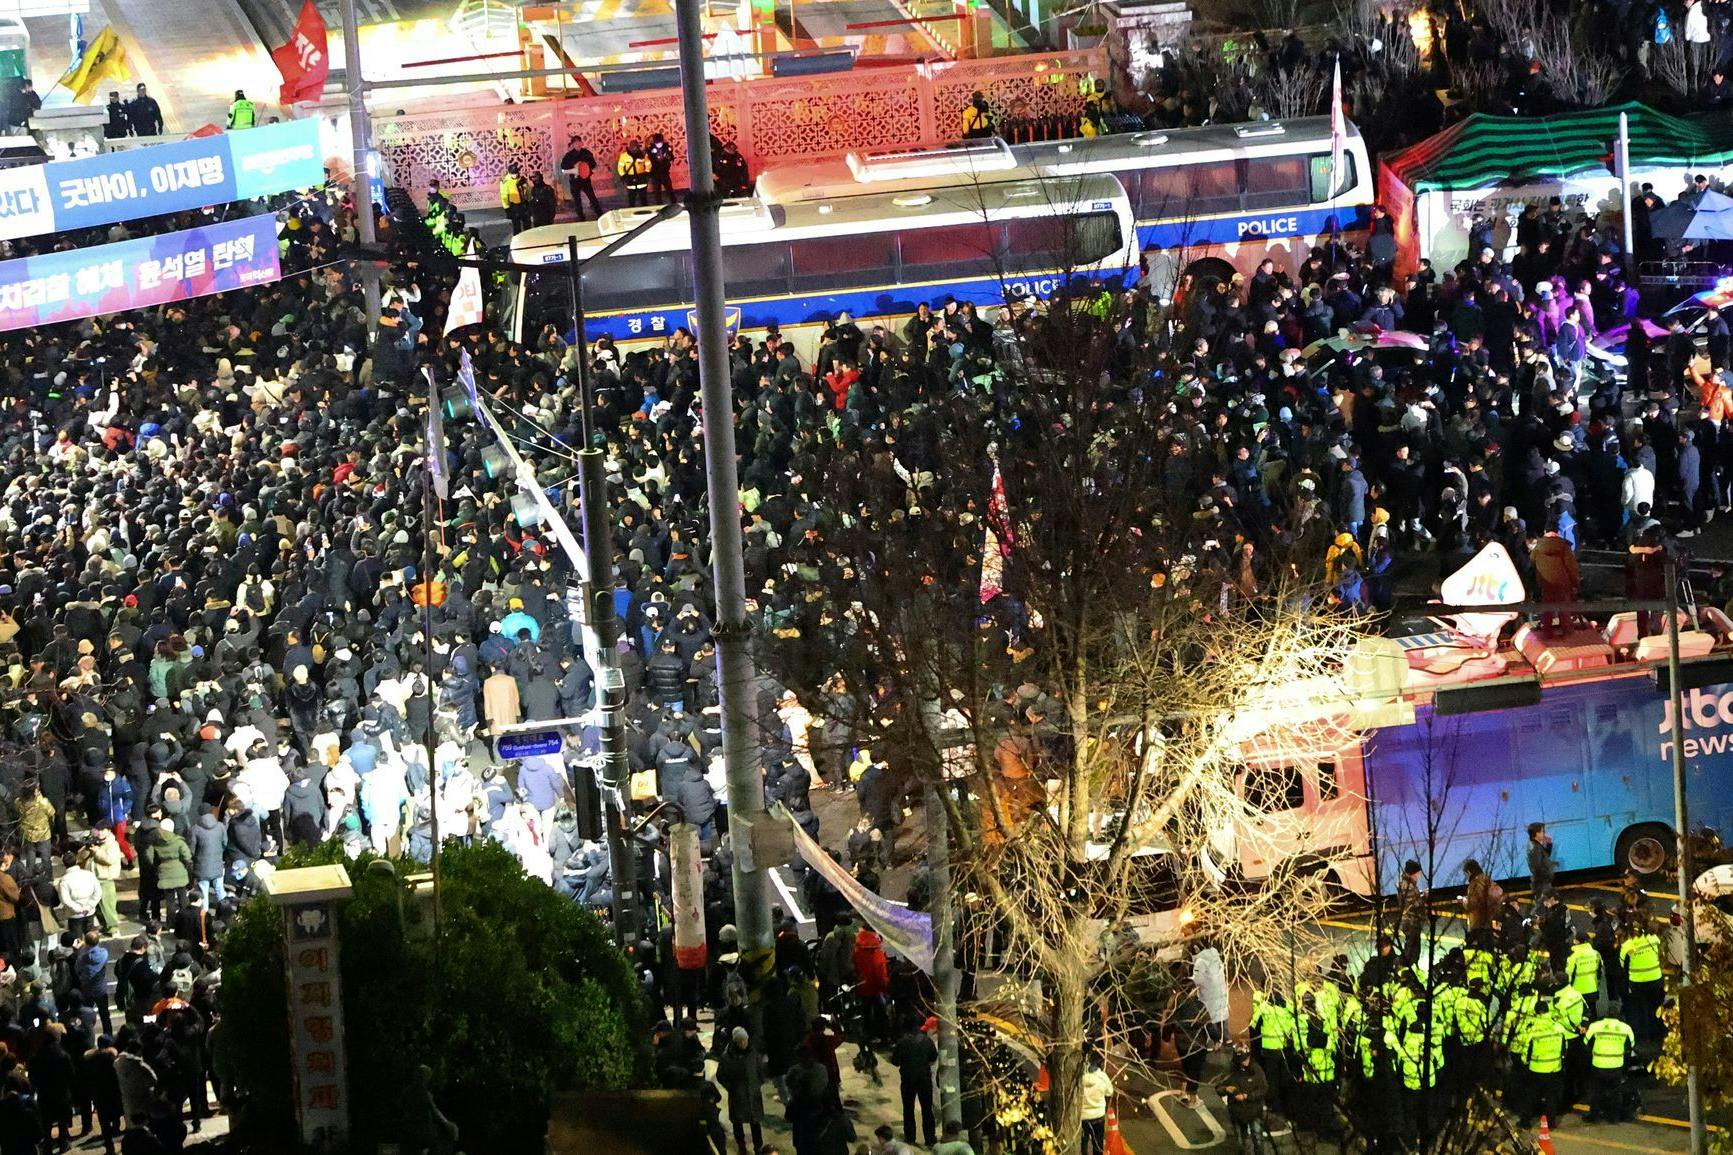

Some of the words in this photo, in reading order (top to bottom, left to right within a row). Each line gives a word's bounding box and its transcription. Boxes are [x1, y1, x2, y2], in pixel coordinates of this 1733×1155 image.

[59, 170, 148, 209] 굿바이,
[150, 154, 225, 194] 이재명
[1238, 217, 1298, 237] POLICE
[138, 247, 206, 290] 윤석열
[1000, 278, 1061, 298] POLICE
[627, 315, 666, 334] 경찰
